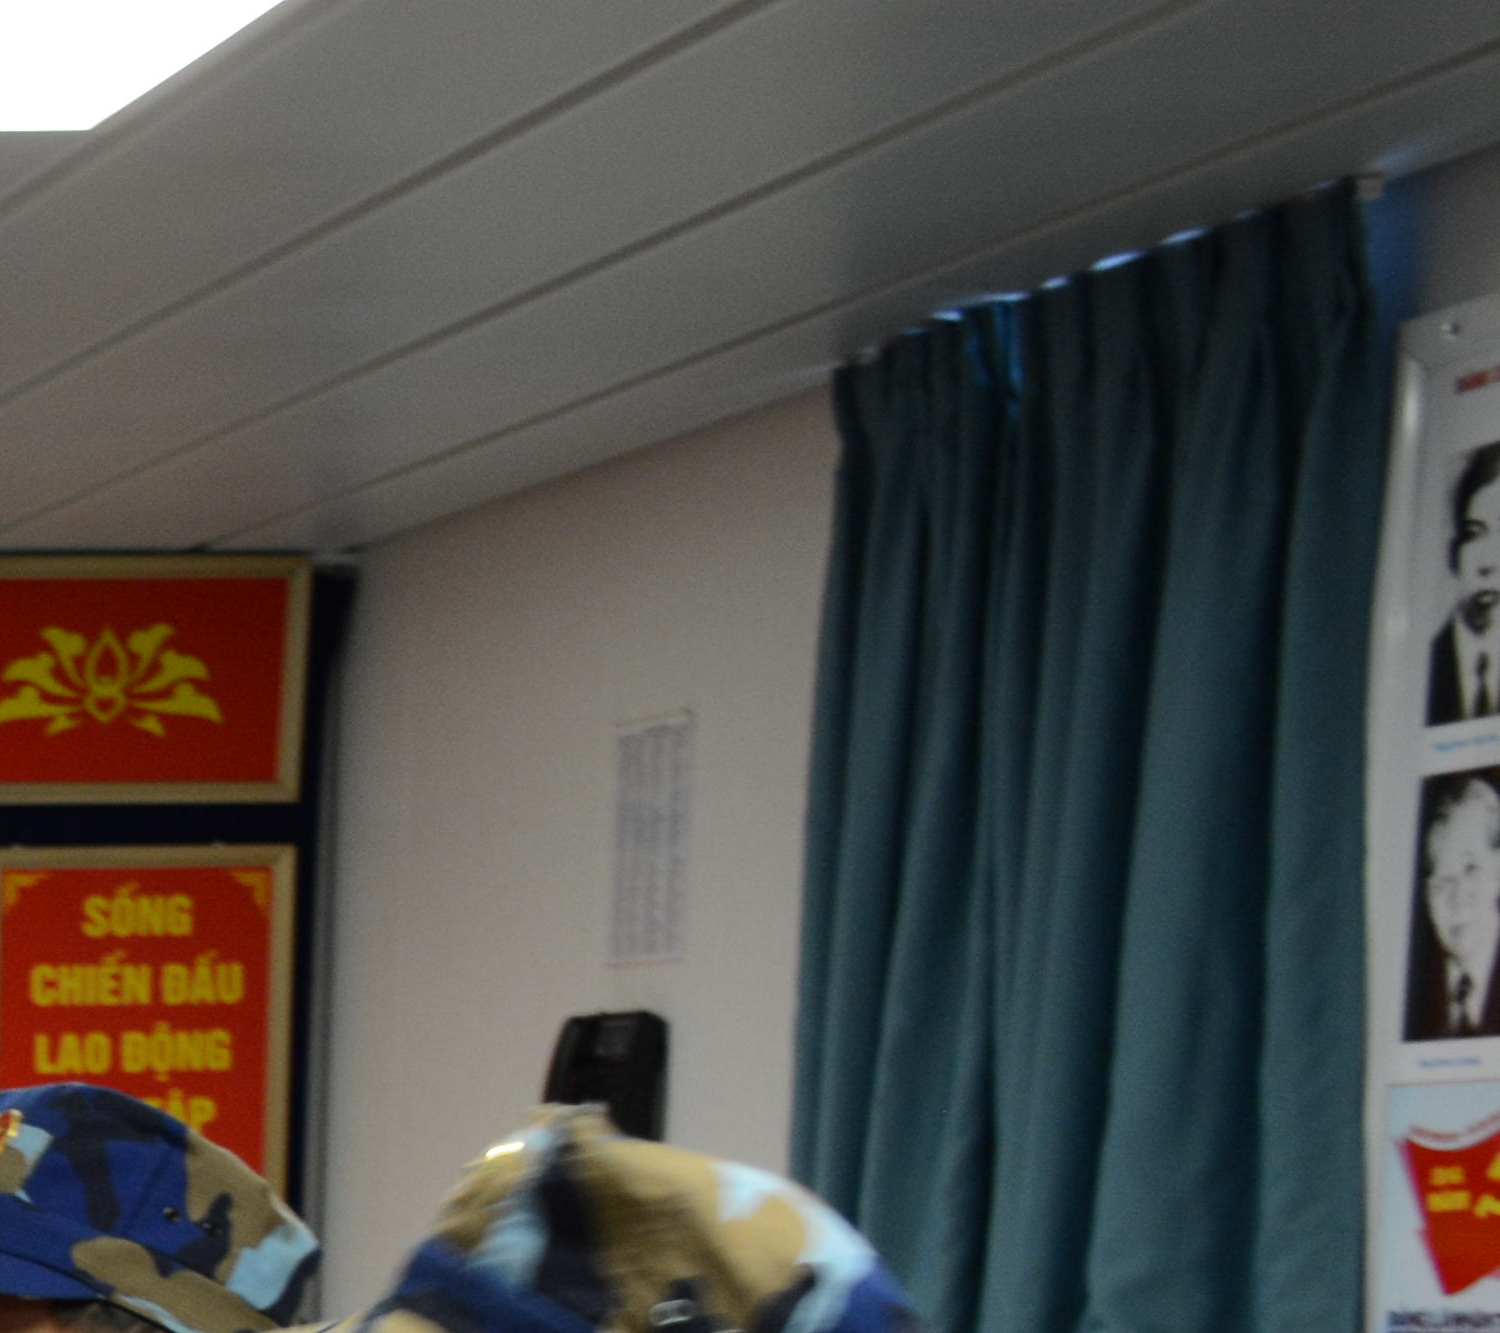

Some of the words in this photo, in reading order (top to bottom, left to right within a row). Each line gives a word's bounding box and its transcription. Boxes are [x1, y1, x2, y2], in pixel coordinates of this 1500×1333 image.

[81, 882, 194, 938] SỐNG
[30, 949, 150, 1008] CHIẾN
[33, 1032, 112, 1076] LAO
[120, 1021, 234, 1083] ĐỘNG
